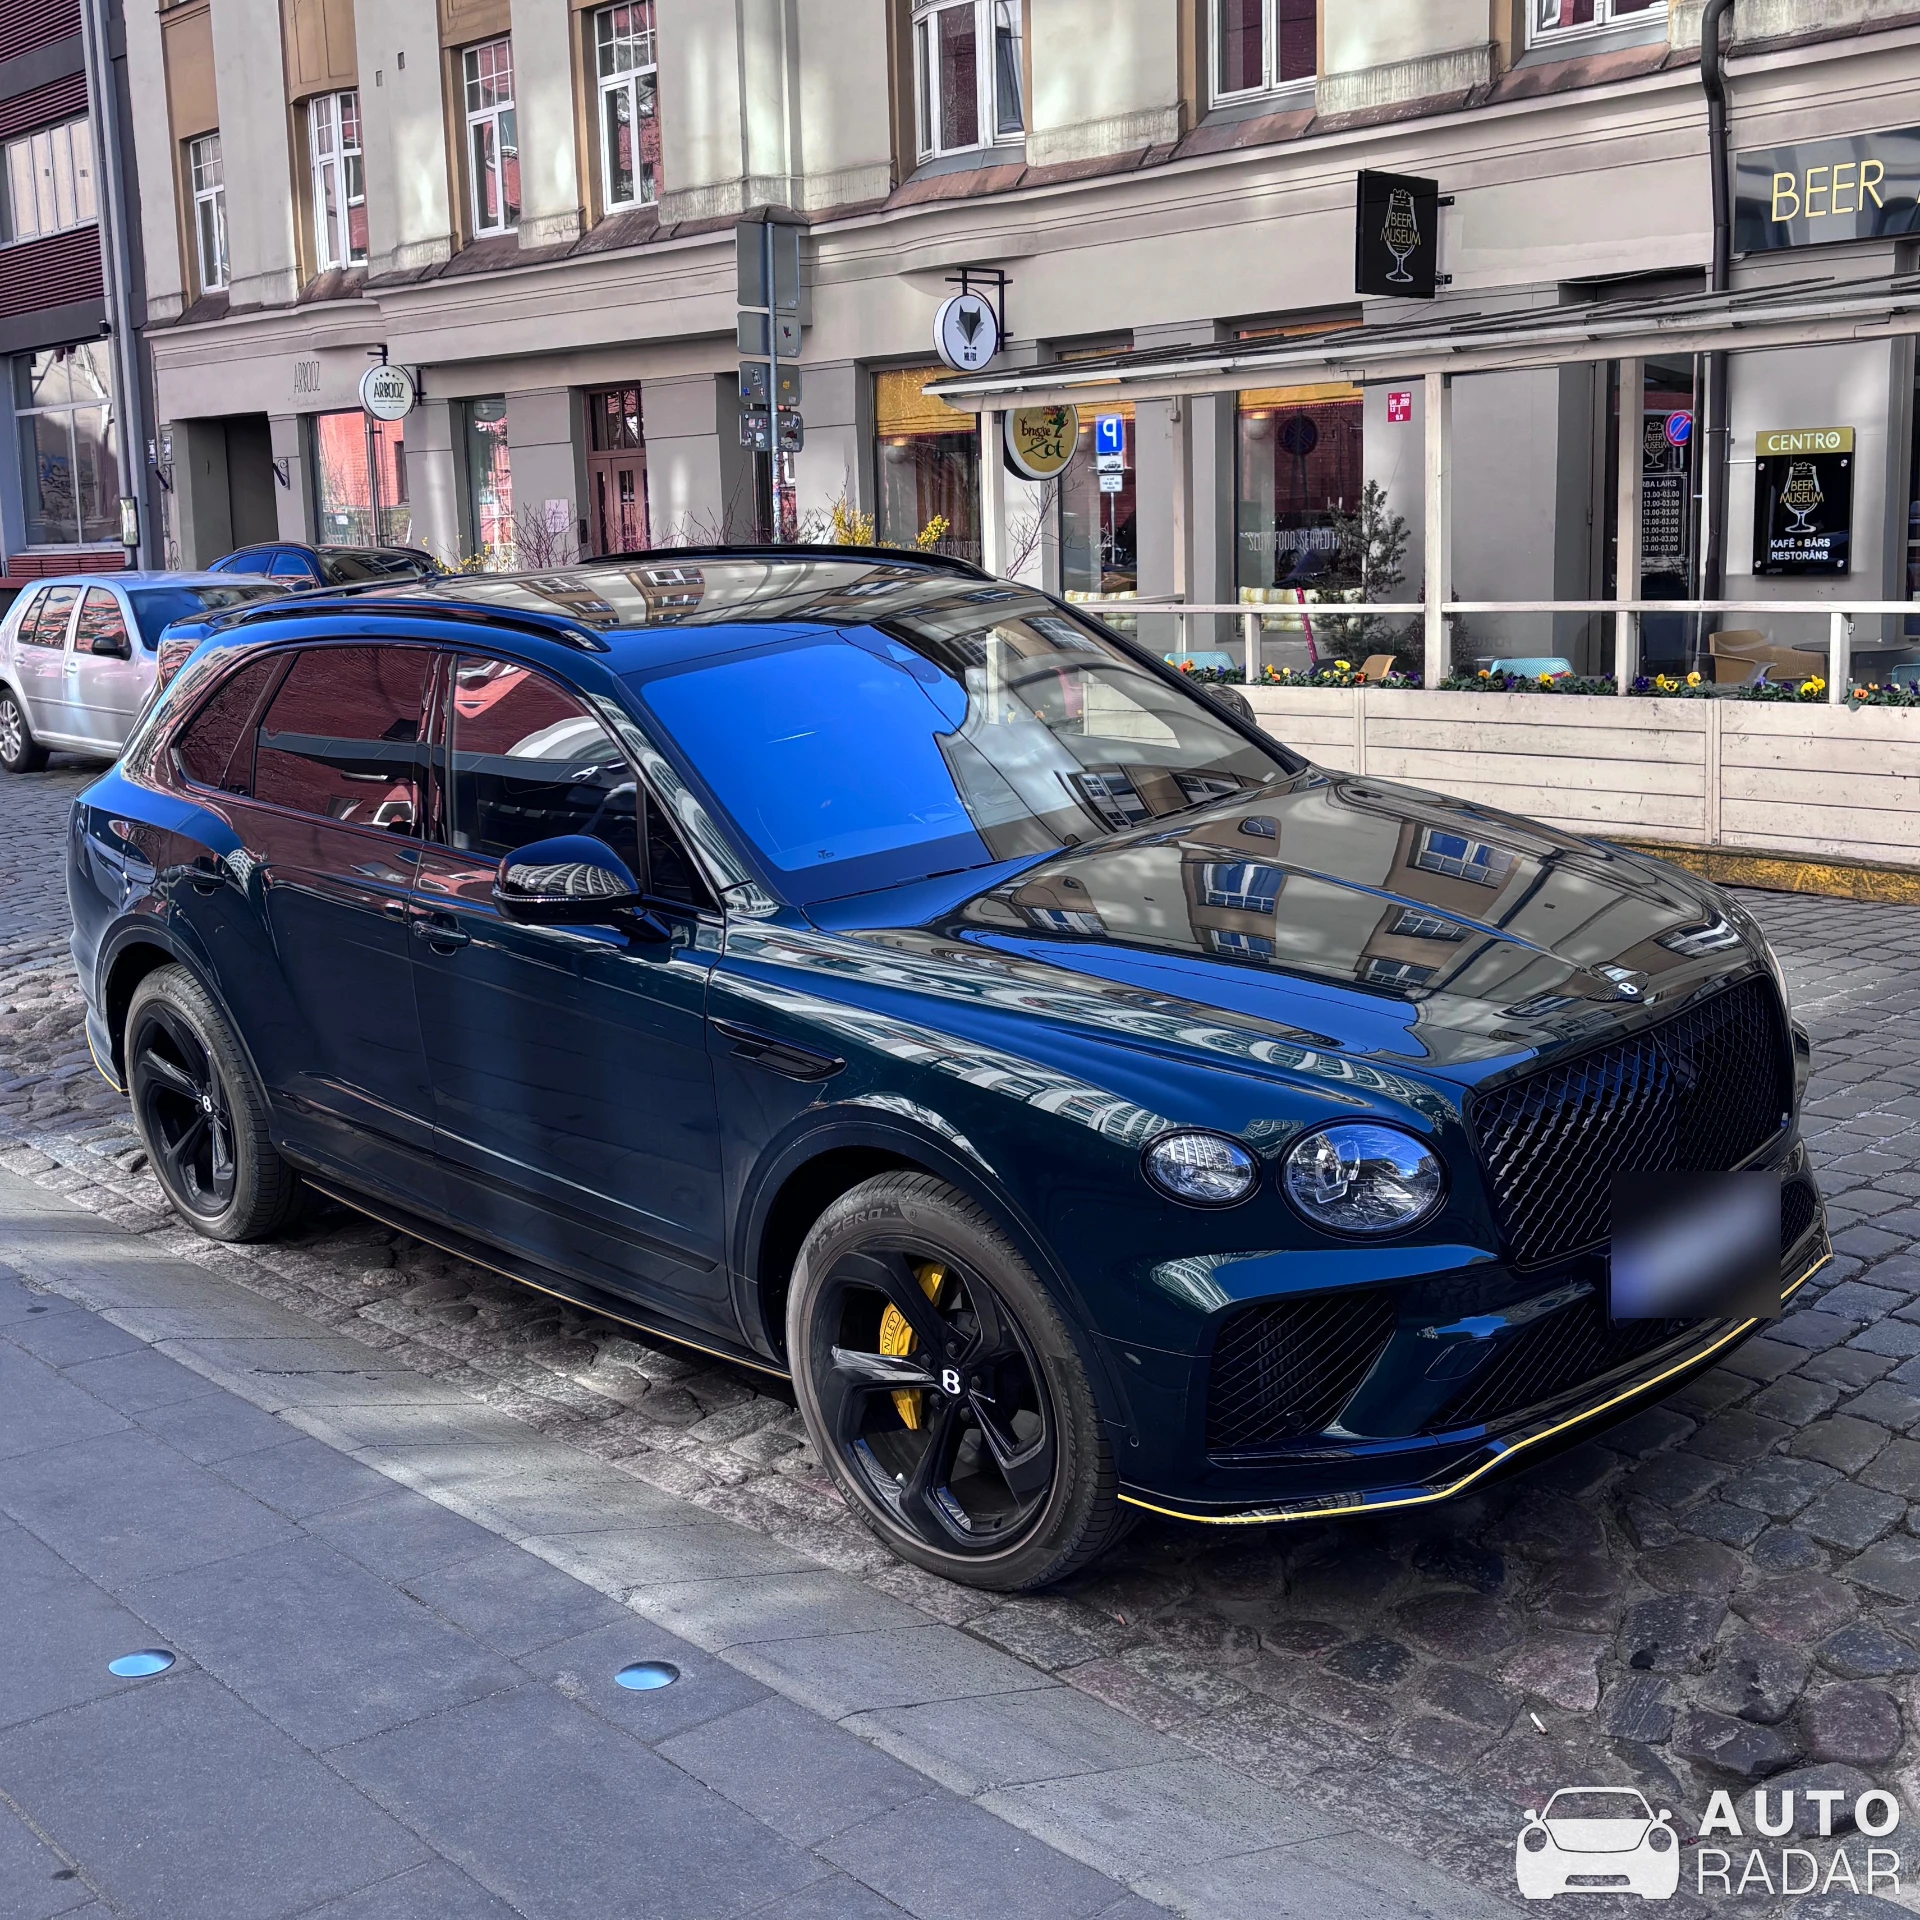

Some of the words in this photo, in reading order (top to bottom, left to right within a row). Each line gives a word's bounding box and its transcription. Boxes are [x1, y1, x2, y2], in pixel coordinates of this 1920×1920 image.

[1771, 159, 1884, 222] BEER
[1390, 212, 1412, 228] BEER
[1380, 227, 1421, 245] MUSEUM
[293, 361, 321, 393] ARBOOZ
[373, 381, 405, 398] ARBOOZ
[1647, 433, 1663, 441] BEER
[1768, 431, 1840, 451] CENTRO
[1023, 438, 1068, 459] Zot
[1790, 480, 1814, 491] BEER
[1779, 491, 1825, 504] MUSEUM
[1248, 531, 1271, 551] SLOW
[1274, 531, 1295, 551] FOOD
[1300, 530, 1330, 550] SERVED
[1804, 537, 1831, 548] BĀRS
[1771, 549, 1829, 560] RESTORĀNS
[831, 1208, 883, 1238] ZERO
[942, 1369, 961, 1394] B
